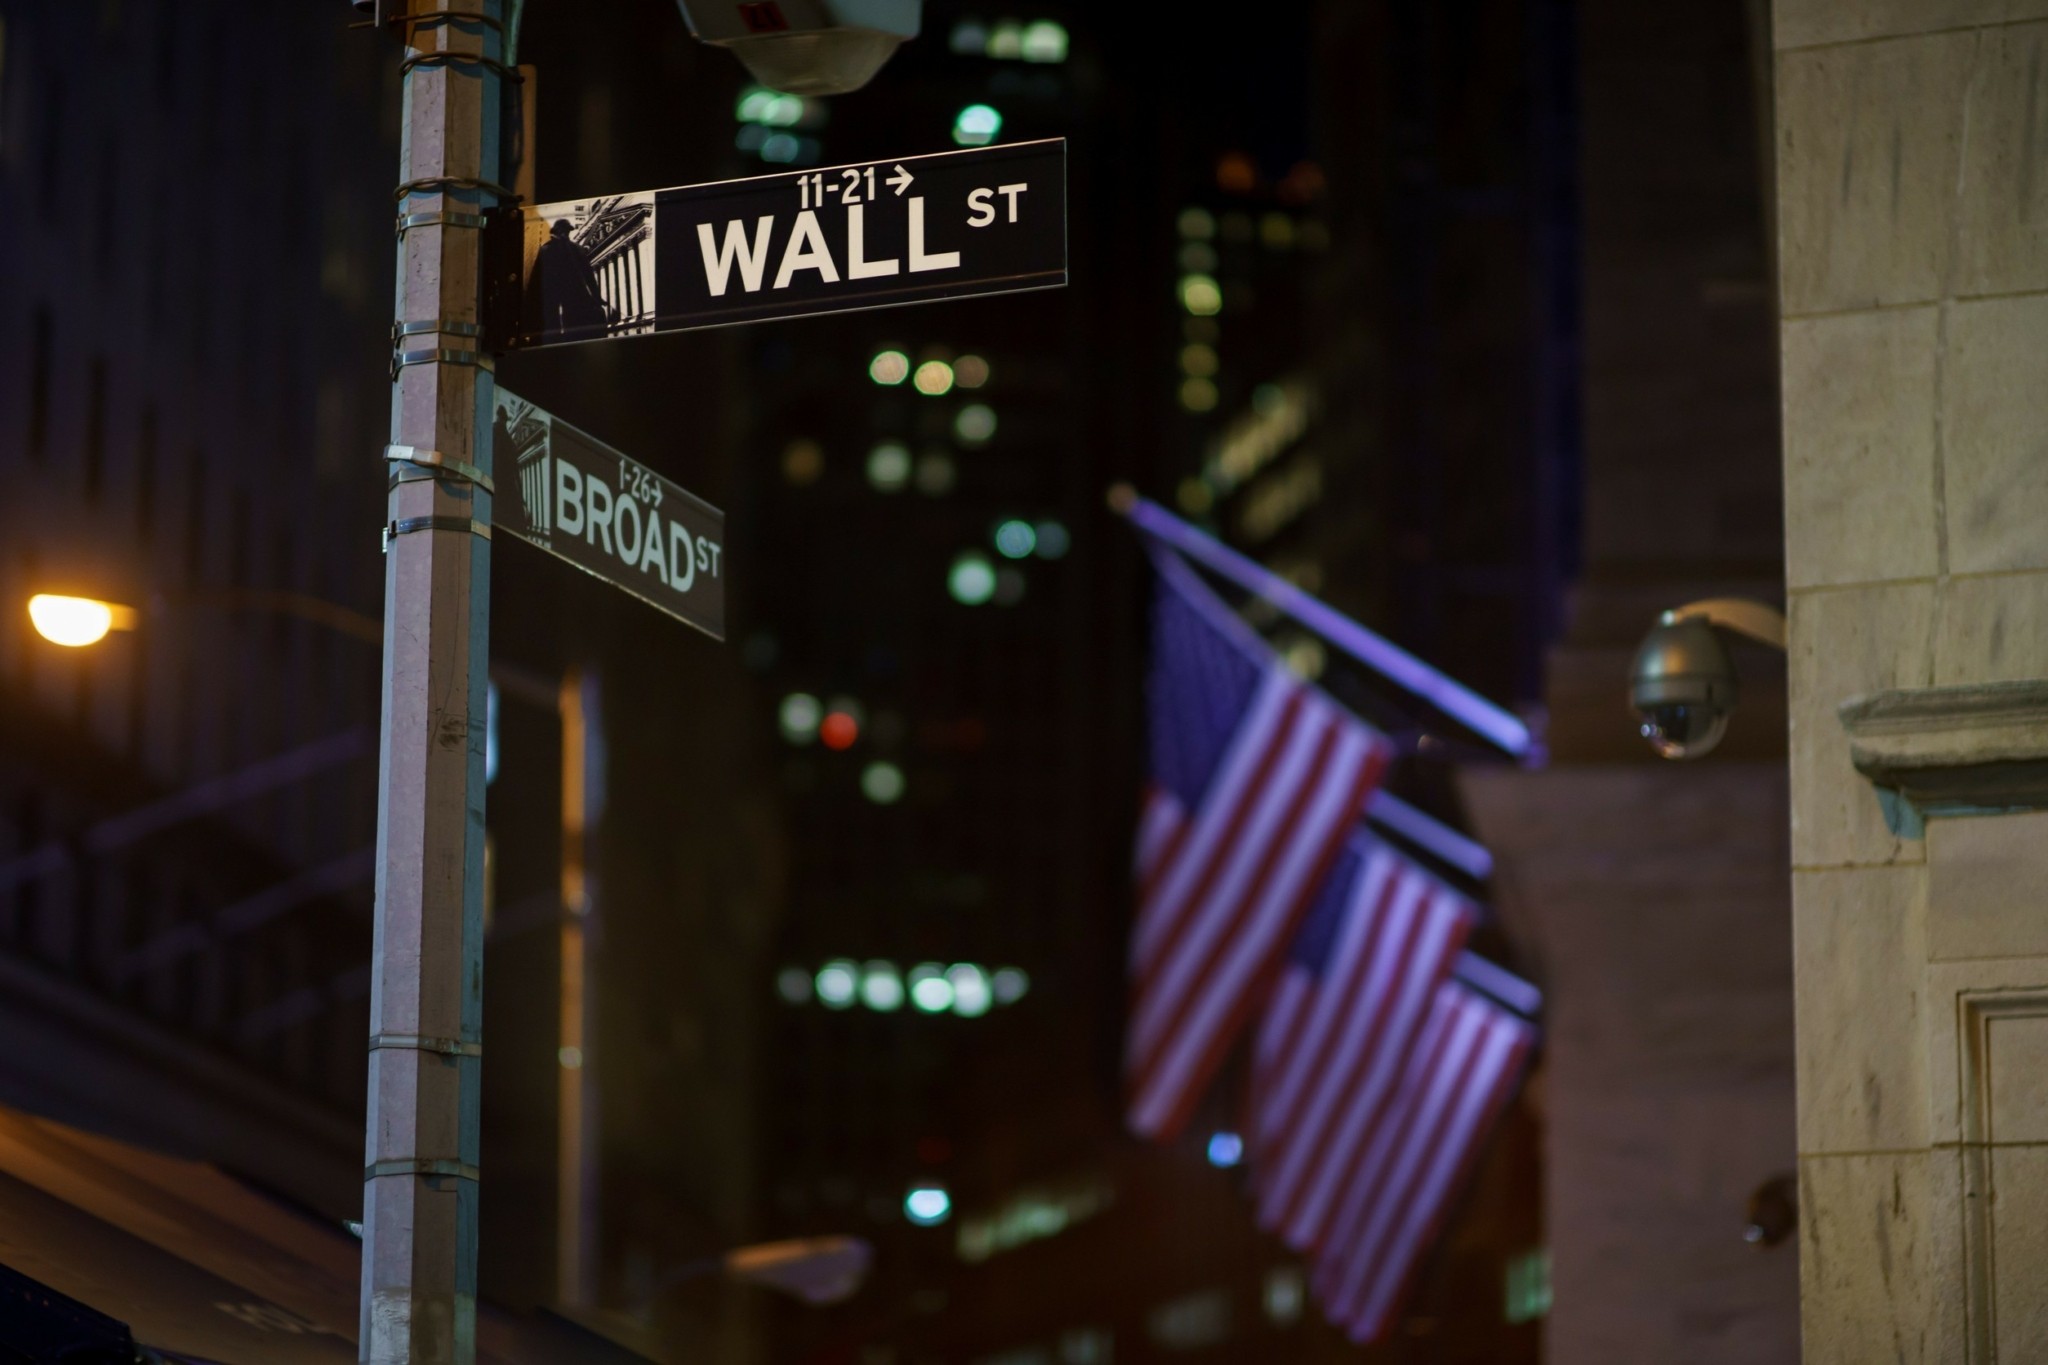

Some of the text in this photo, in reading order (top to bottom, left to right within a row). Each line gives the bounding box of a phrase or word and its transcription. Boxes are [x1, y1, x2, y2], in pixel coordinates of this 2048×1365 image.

[797, 166, 877, 209] 11-21
[697, 183, 1028, 297] WALL ST
[618, 459, 651, 503] 1-26
[556, 457, 721, 592] BROAD ST
